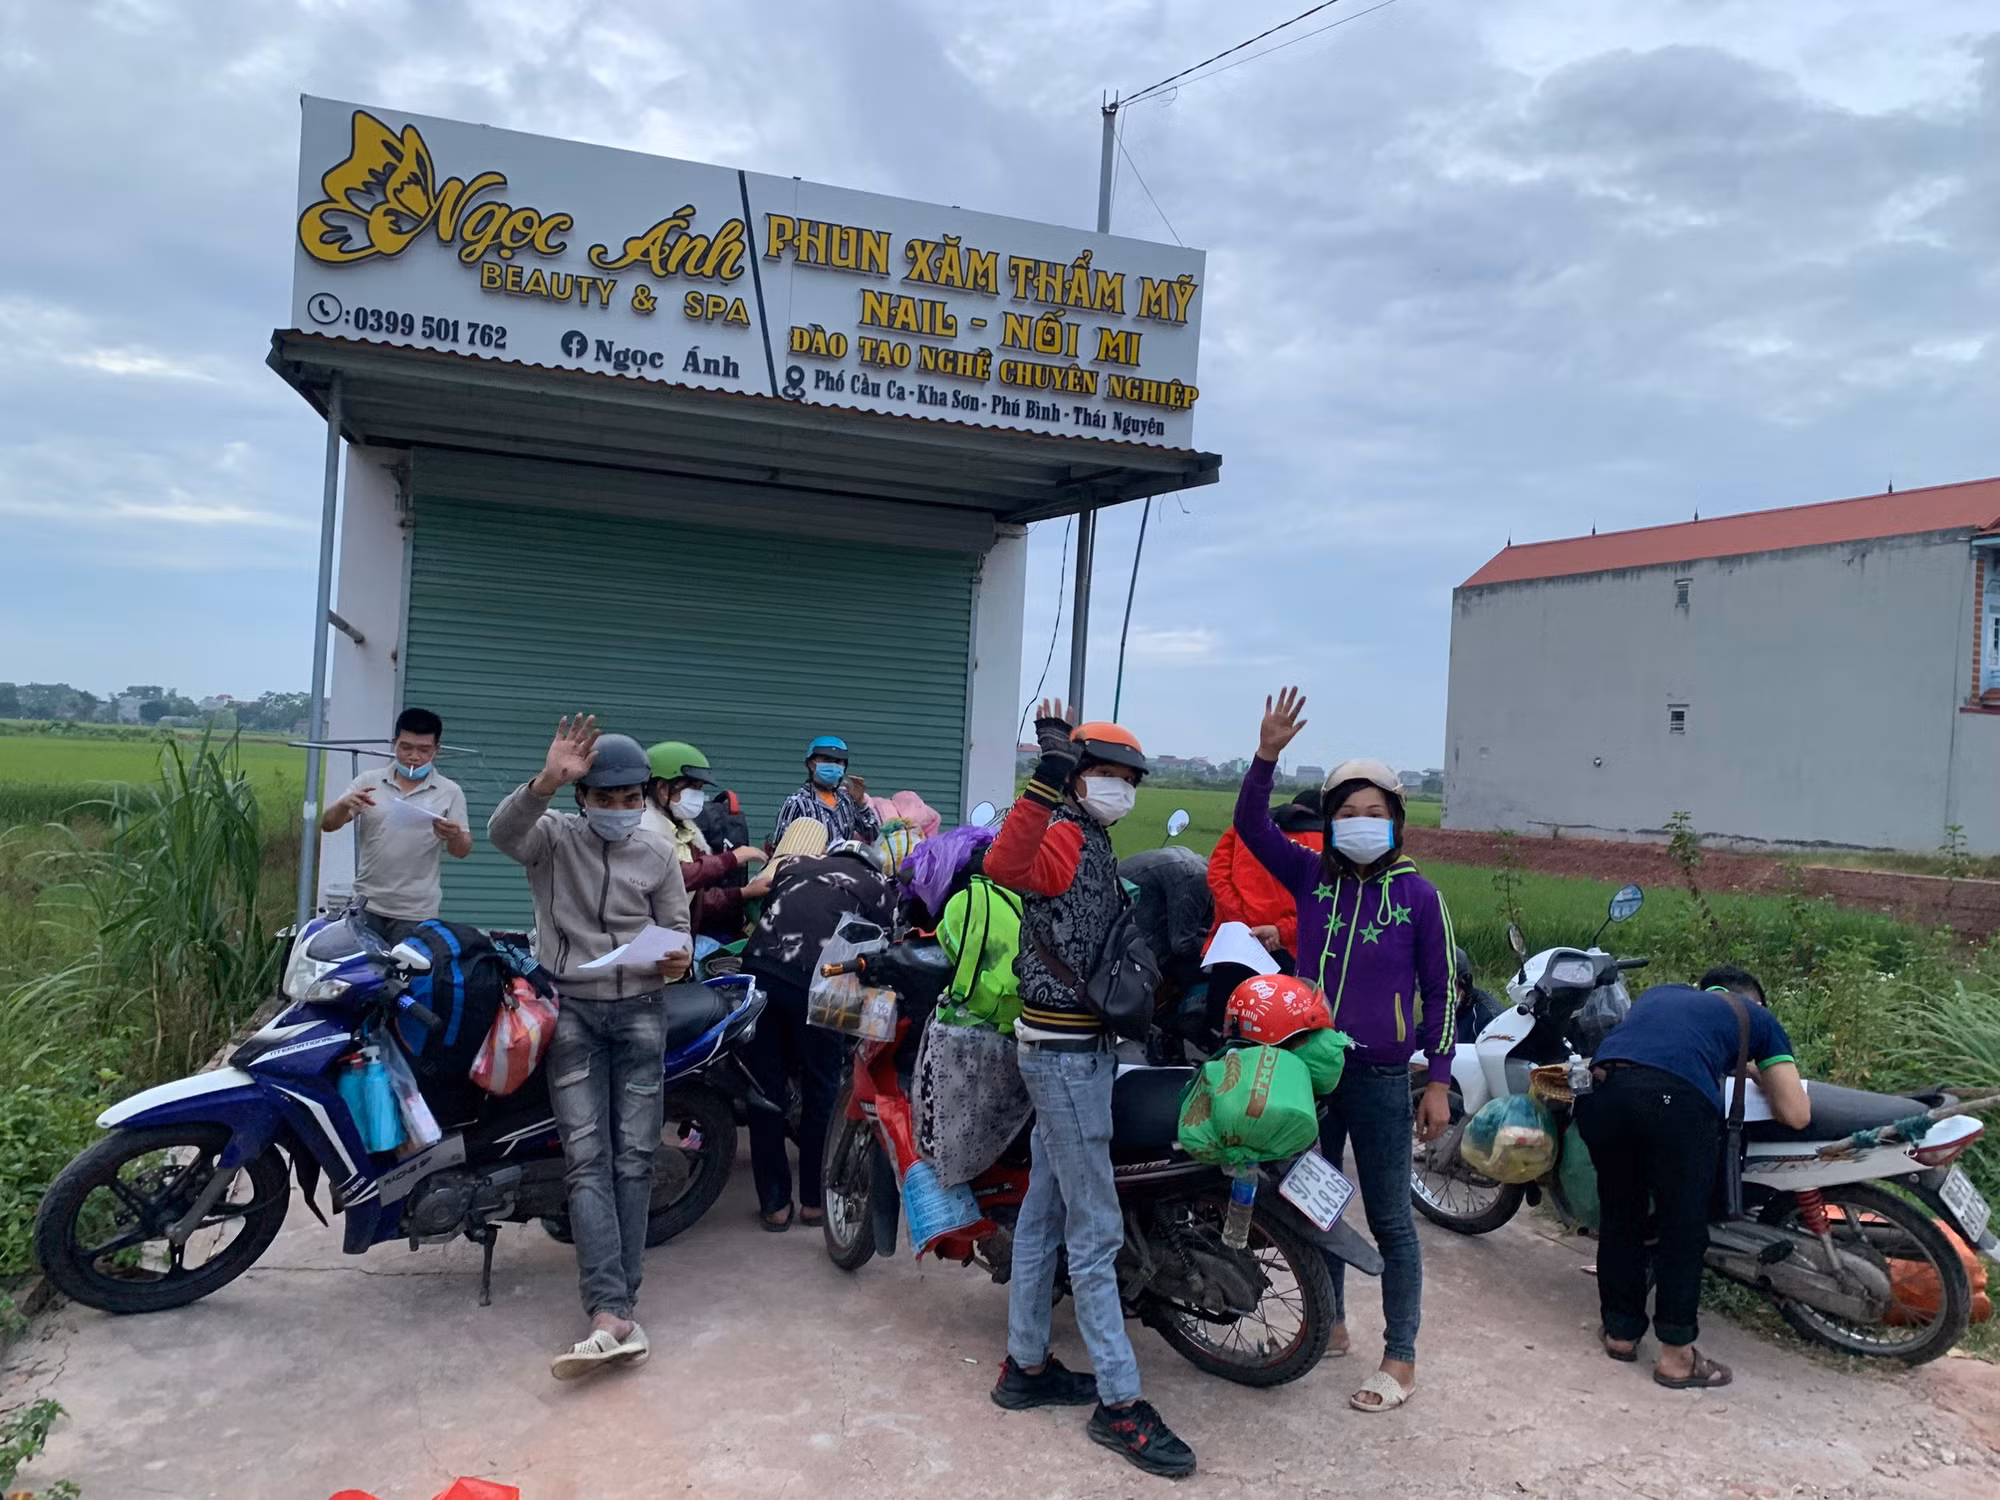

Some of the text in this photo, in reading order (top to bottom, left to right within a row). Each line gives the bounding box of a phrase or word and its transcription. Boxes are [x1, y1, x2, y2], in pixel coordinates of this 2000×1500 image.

[434, 171, 746, 280] Ngọc Ánh
[481, 261, 751, 326] BEAUTY & SPA
[763, 213, 1199, 324] PHUN XĂM THẨM MỸ
[421, 315, 459, 343] 501
[467, 321, 507, 350] 762
[594, 339, 664, 373] Ngọc
[682, 345, 740, 379] Ánh
[857, 288, 958, 338] NAIL
[1001, 309, 1081, 359] NỐI
[1094, 327, 1143, 367] MI
[790, 323, 848, 359] ĐÀO
[859, 336, 912, 369] TẠO
[1000, 359, 1099, 395] CHUYÊN
[1107, 373, 1200, 413] NGHIỆP
[814, 369, 845, 392] Phố
[851, 372, 881, 398] Cầu
[887, 380, 905, 401] Ca
[917, 384, 948, 407] Kha
[952, 389, 979, 412] Sơn
[991, 395, 1020, 417] Phú
[1026, 399, 1060, 422] Bình
[1113, 411, 1165, 437] Nguyên
[1286, 1156, 1327, 1200] 97-B1
